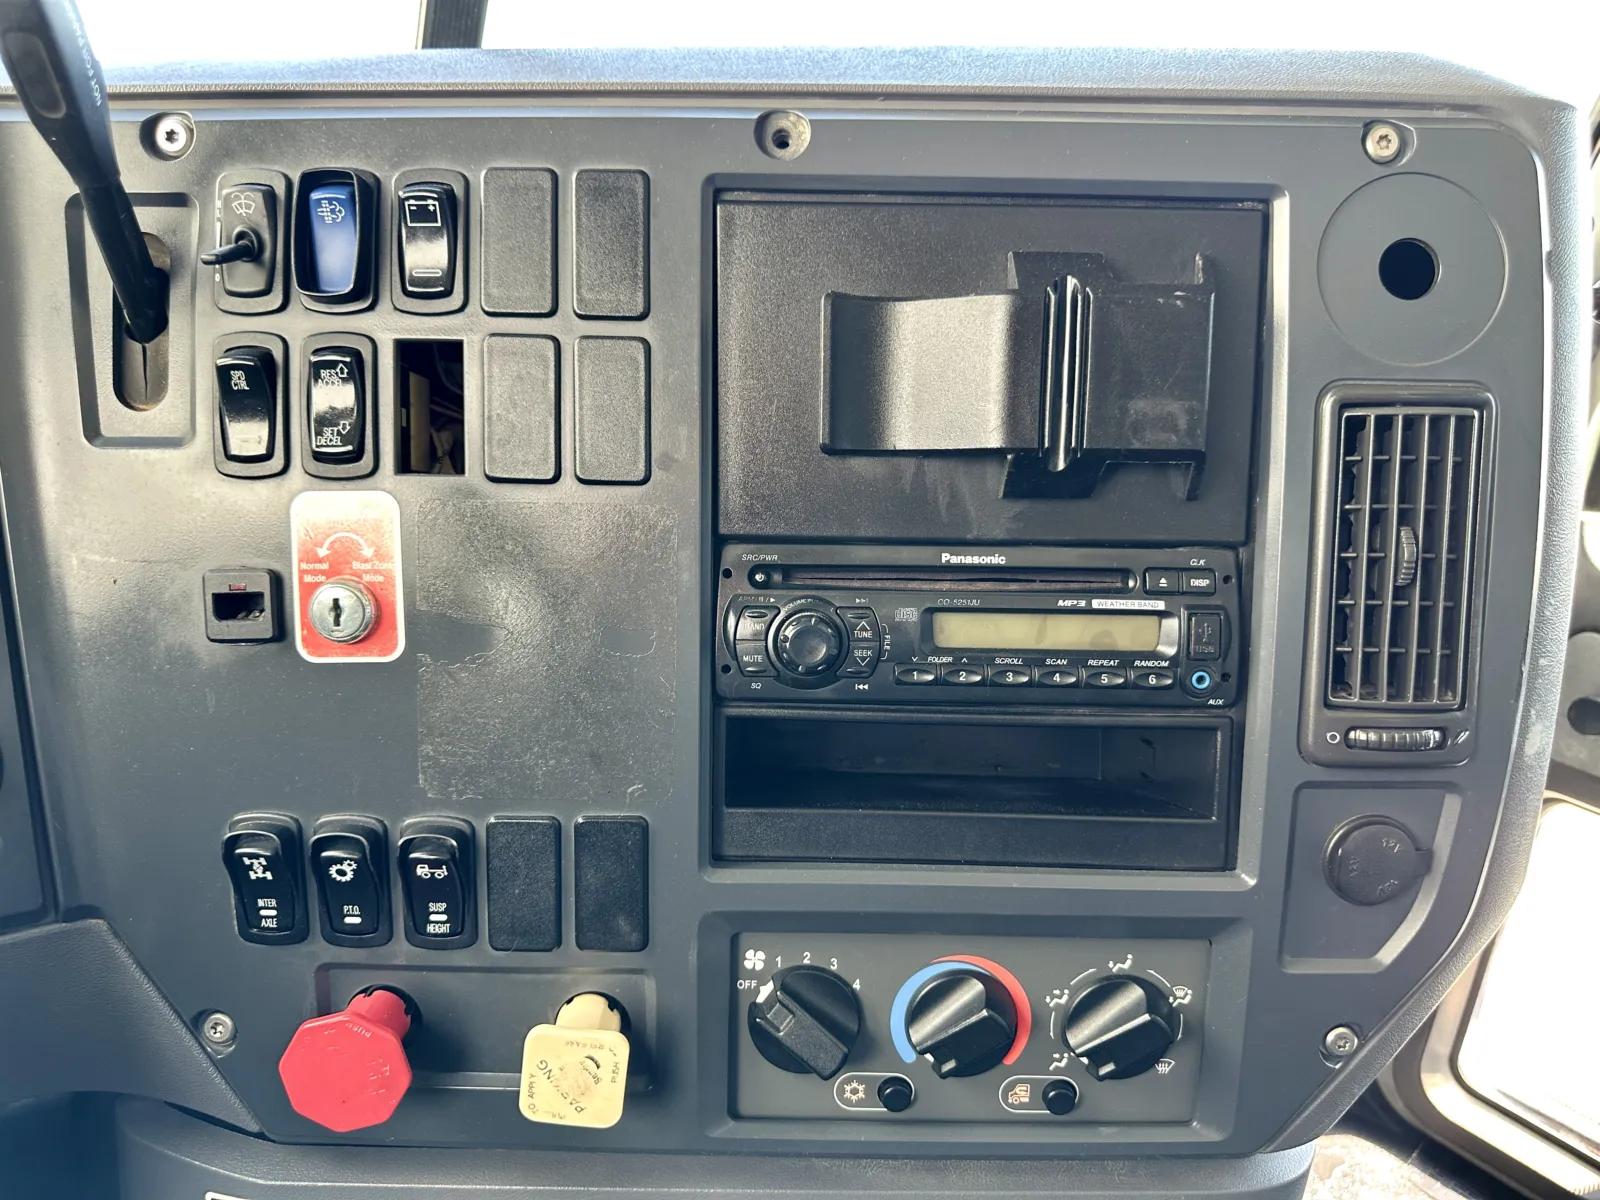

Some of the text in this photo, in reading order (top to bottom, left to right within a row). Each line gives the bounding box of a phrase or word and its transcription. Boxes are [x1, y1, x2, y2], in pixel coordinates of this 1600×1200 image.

[230, 370, 245, 380] SPD
[231, 380, 250, 390] CTRL
[323, 427, 338, 437] SET
[317, 436, 342, 446] DECEL
[941, 552, 1006, 564] Panasonic
[300, 561, 329, 570] Normal
[304, 574, 326, 582] Mode
[363, 574, 384, 582] Mode
[1190, 579, 1210, 587] DISP
[1057, 599, 1087, 607] MP3
[1137, 601, 1160, 609] BAND
[742, 654, 763, 662] MUTE
[853, 649, 873, 657] SEEK
[912, 671, 917, 680] 1
[959, 671, 966, 681] 2
[1006, 672, 1013, 682] 3
[1053, 673, 1060, 682] 4
[1100, 674, 1108, 683] 5
[1148, 674, 1156, 685] 6
[257, 898, 277, 907] INTER
[428, 902, 447, 912] SUSP
[343, 905, 361, 915] P.T.O.
[261, 918, 278, 928] AXLE
[426, 923, 451, 933] HEIGHT
[775, 955, 782, 968] 1
[803, 951, 811, 964] 2
[830, 957, 838, 970] 3
[736, 979, 758, 990] OFF
[852, 978, 861, 991] 4
